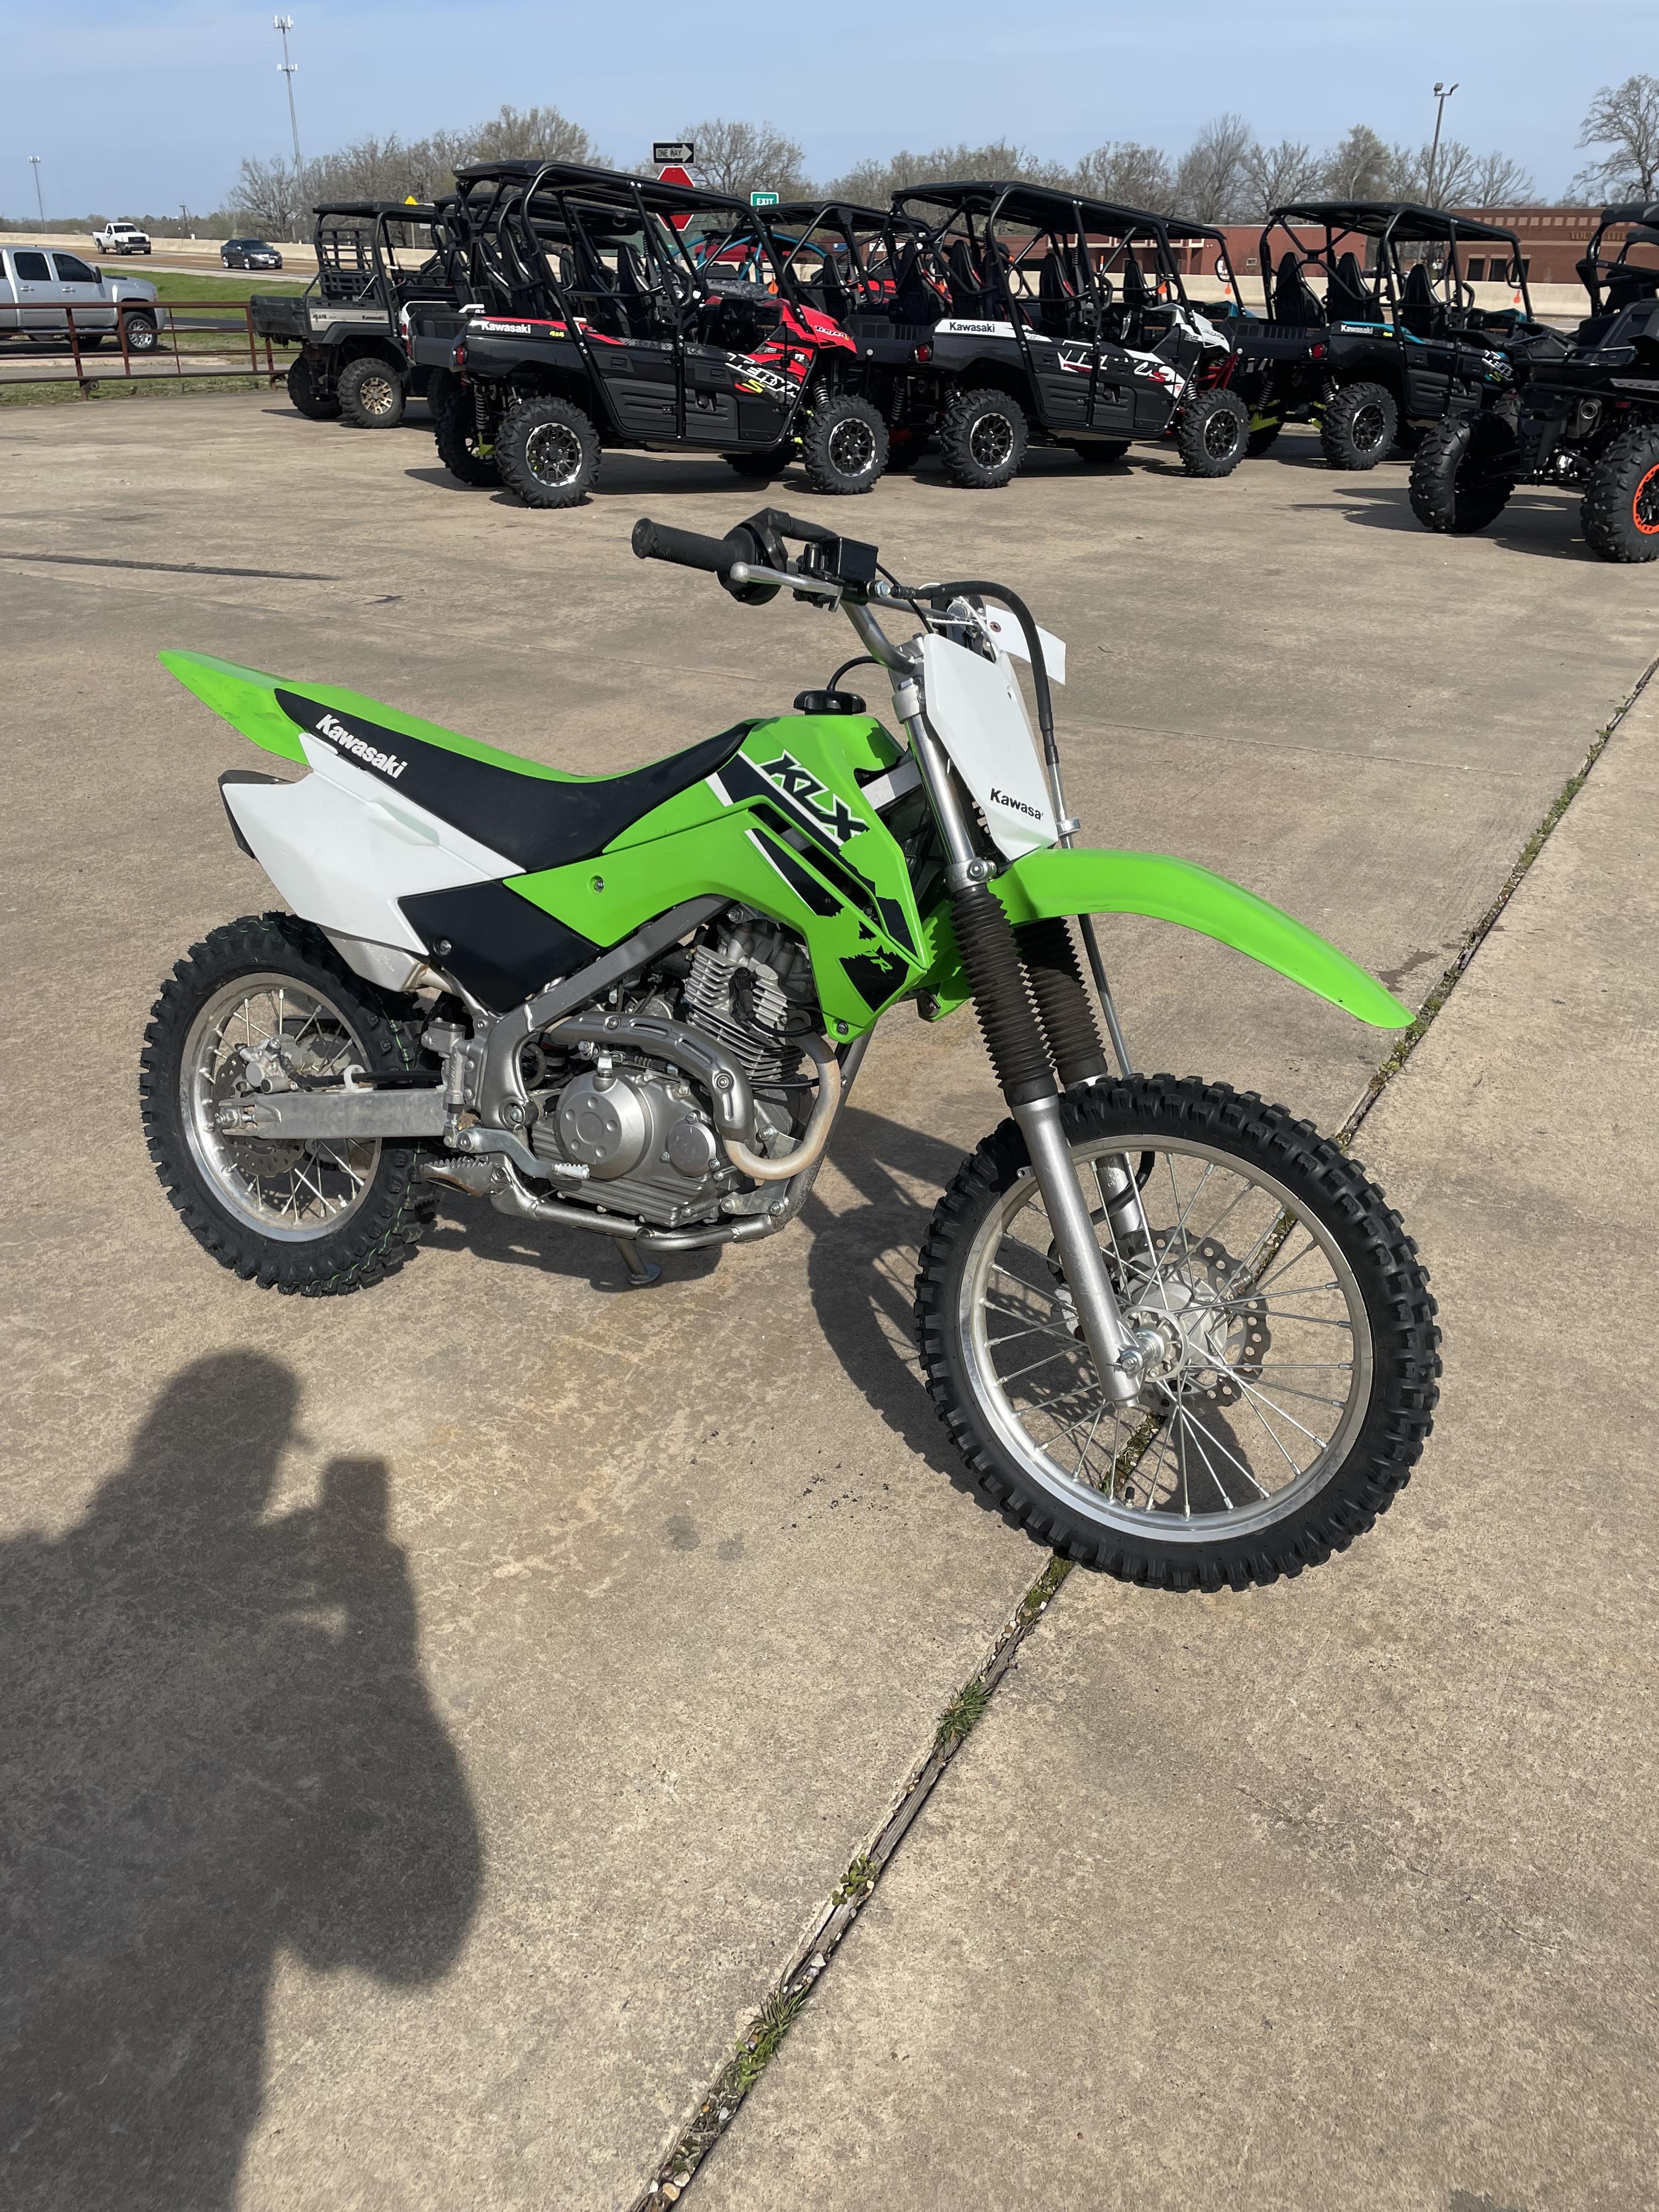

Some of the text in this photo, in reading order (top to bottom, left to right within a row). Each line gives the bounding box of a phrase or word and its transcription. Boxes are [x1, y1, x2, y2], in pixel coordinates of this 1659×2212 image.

[657, 149, 682, 157] ONE WAY
[481, 320, 532, 334] Kawasaki
[949, 321, 995, 332] Kawasaki
[315, 714, 408, 778] Kawasaki
[757, 748, 871, 847] KLX
